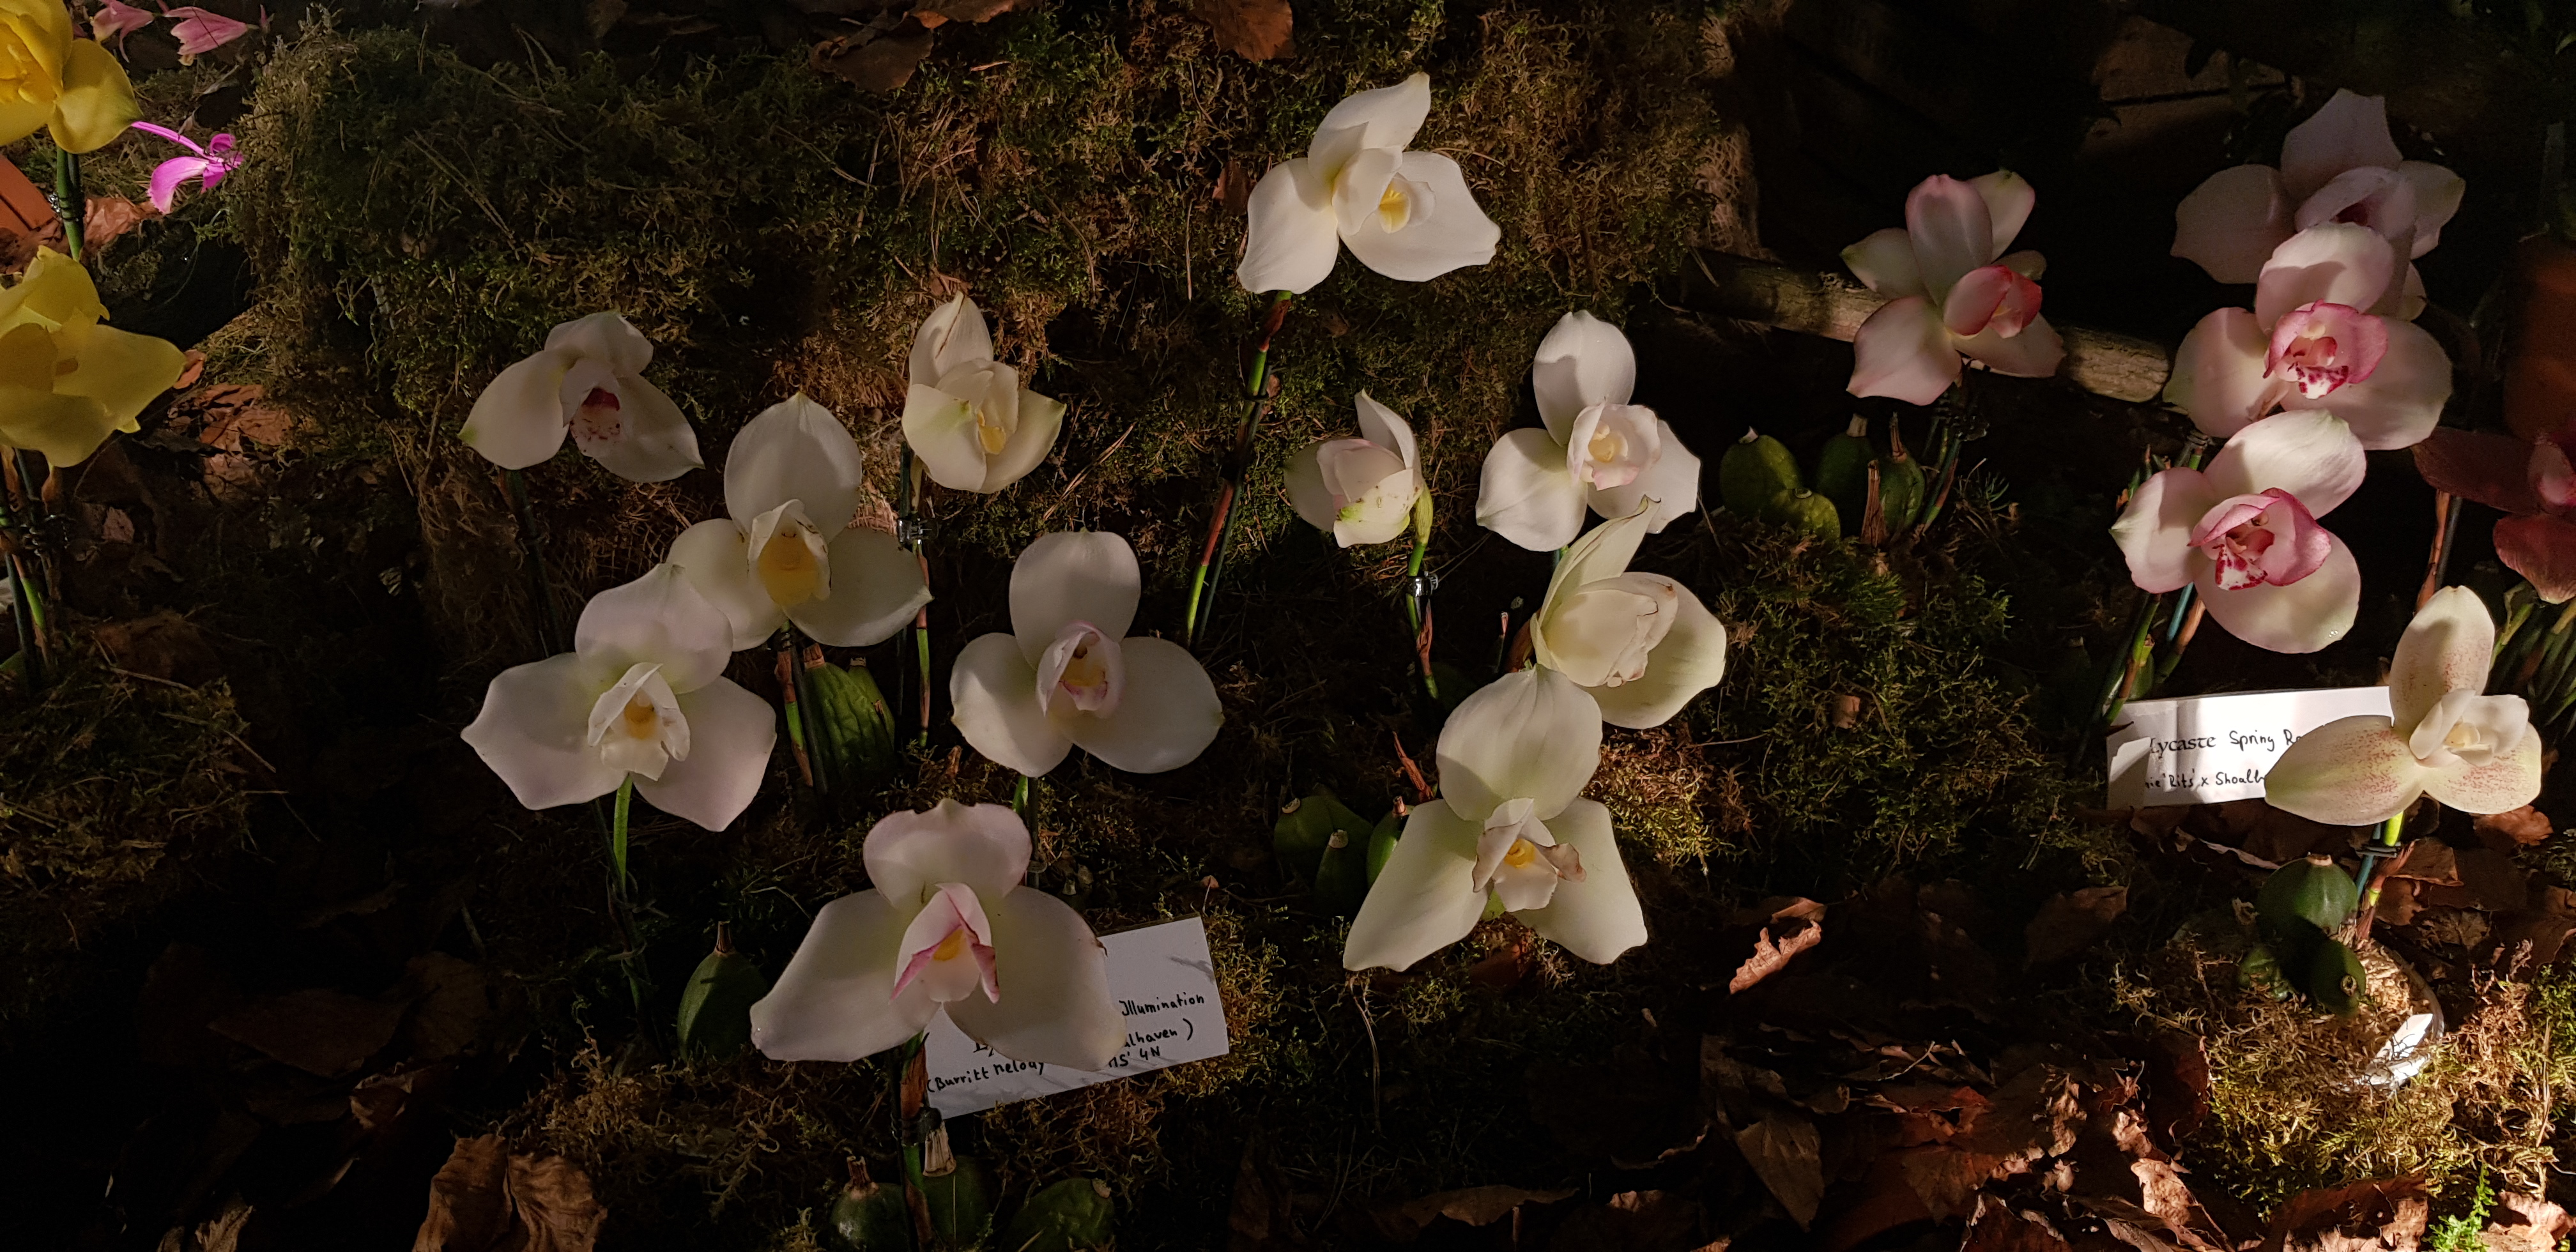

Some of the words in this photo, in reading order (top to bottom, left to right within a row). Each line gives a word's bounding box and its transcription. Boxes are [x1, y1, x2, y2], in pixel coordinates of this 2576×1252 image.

[2150, 737, 2216, 759] Lycaste
[2229, 729, 2275, 752] Spring
[1119, 991, 1204, 1016] Illumination
